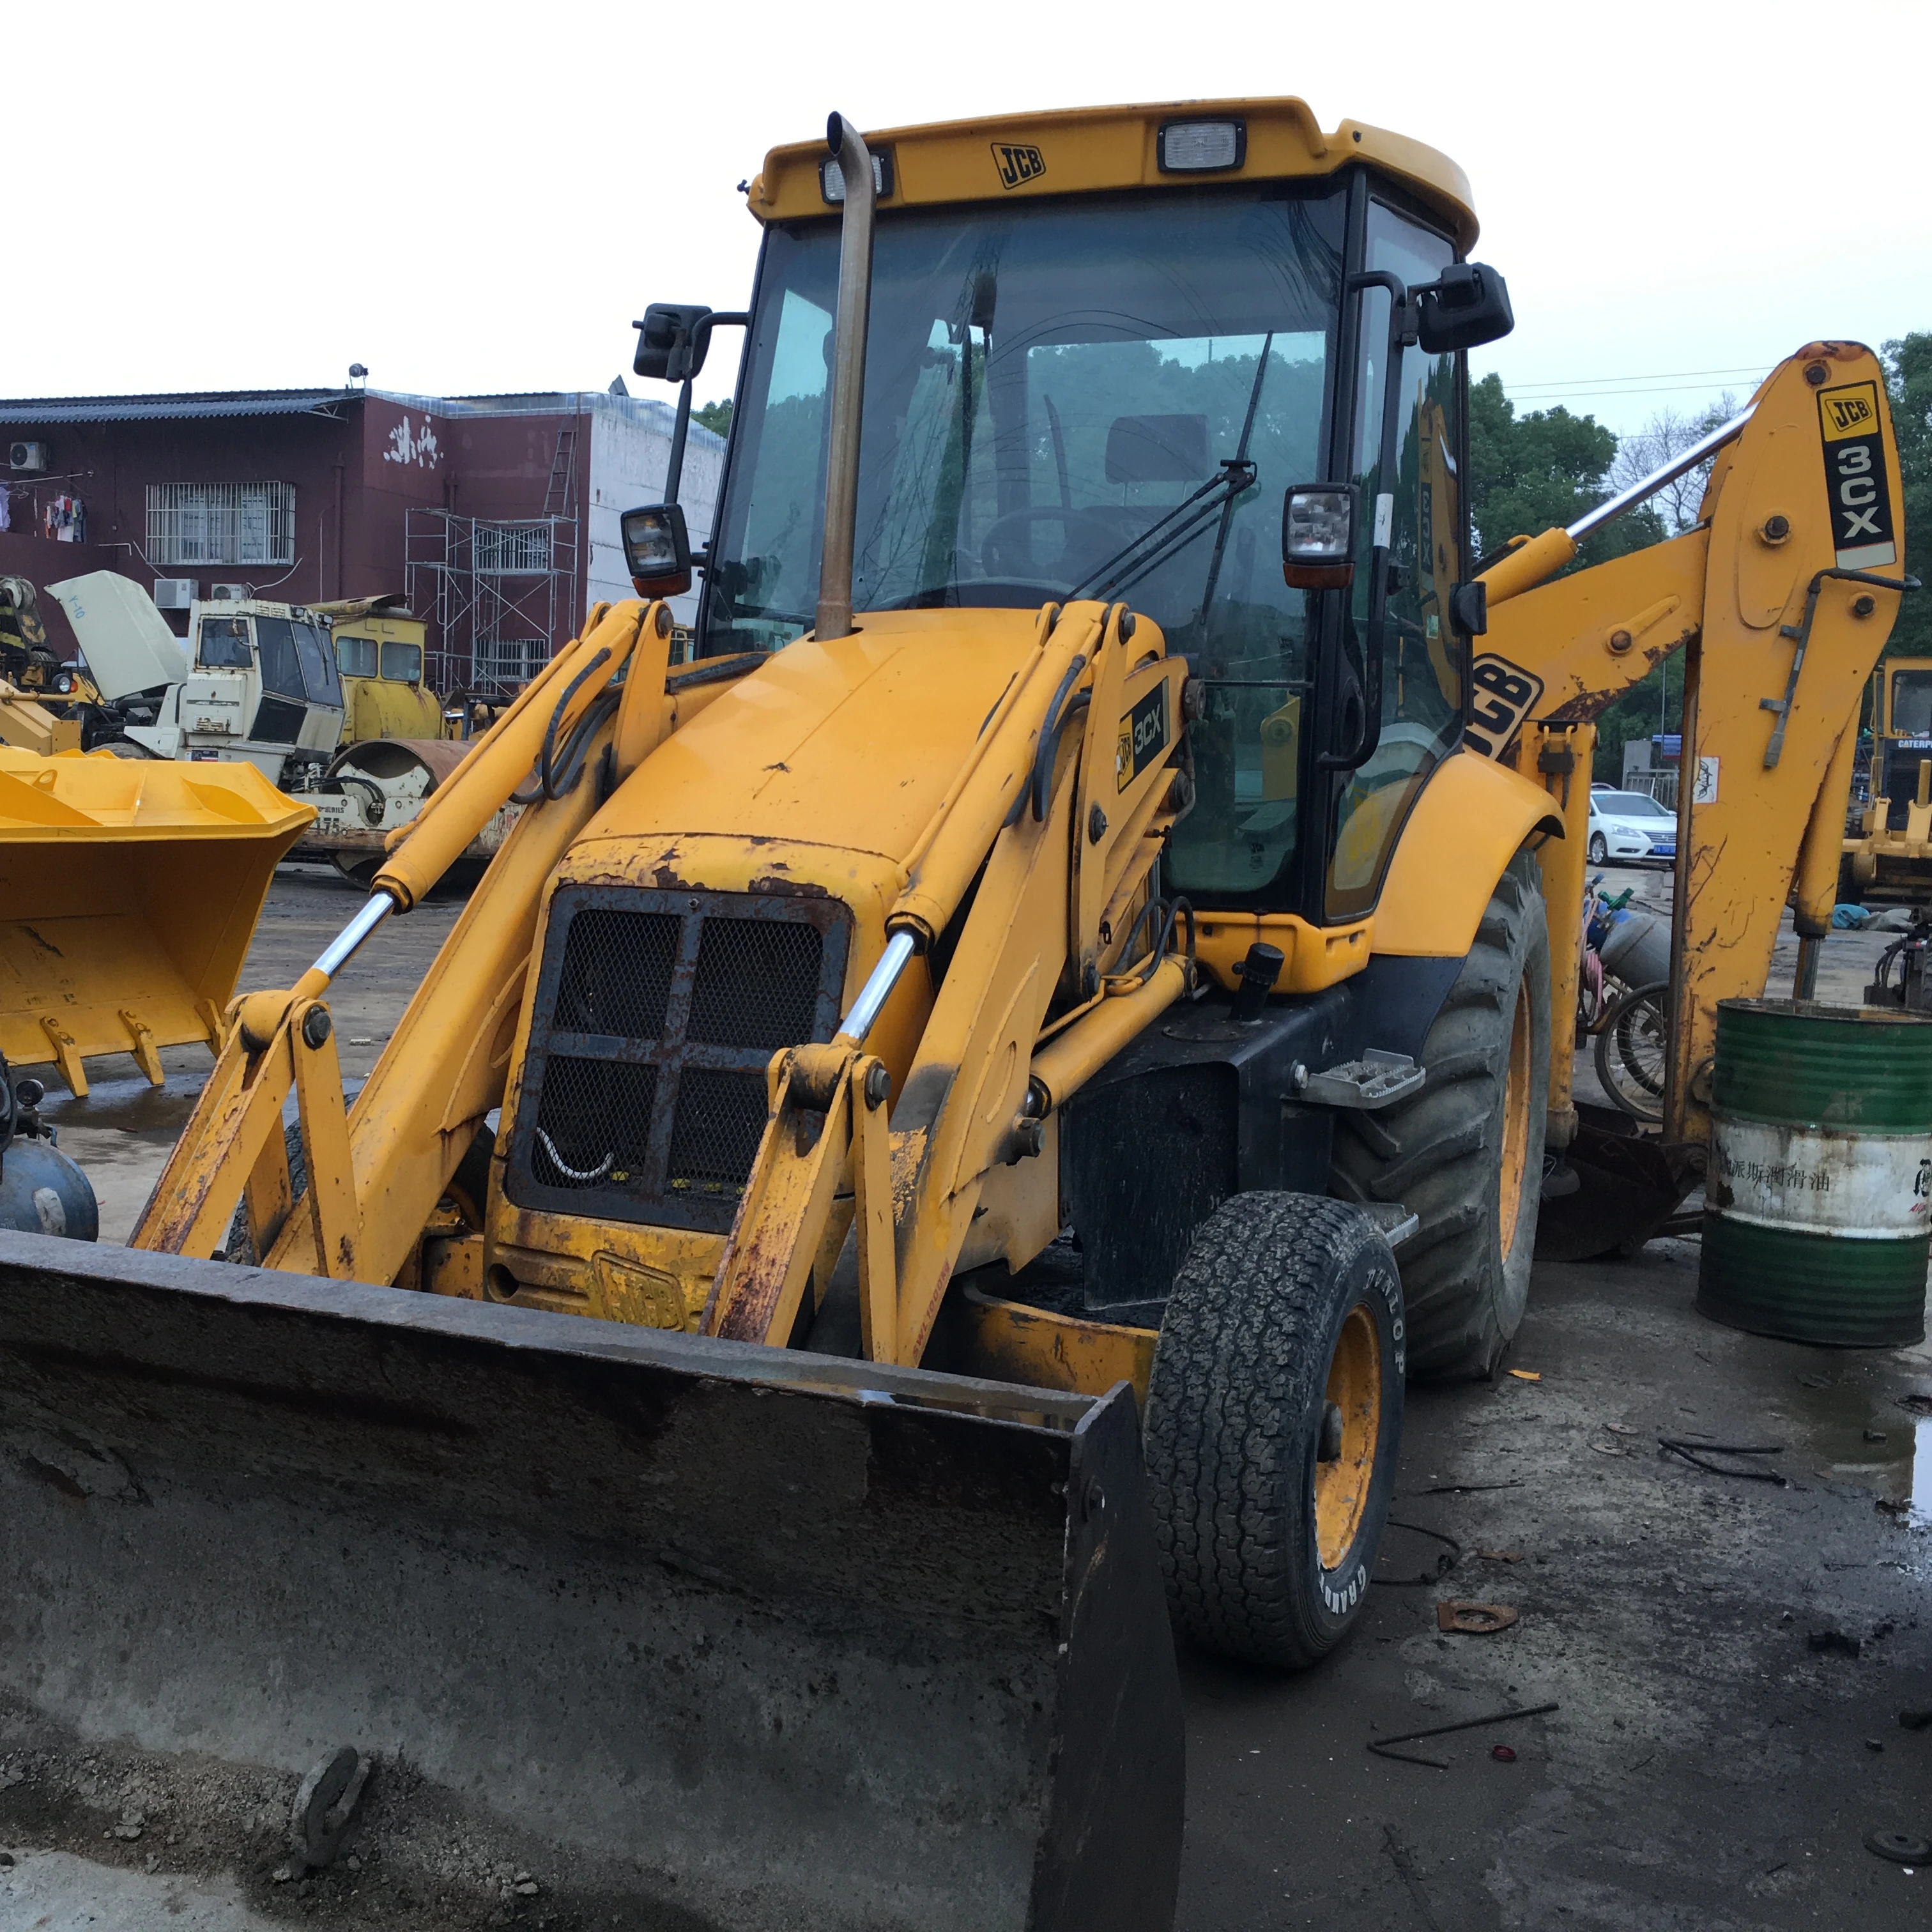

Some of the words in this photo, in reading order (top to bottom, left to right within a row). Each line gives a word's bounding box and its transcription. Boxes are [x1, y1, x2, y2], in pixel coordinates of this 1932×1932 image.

[1000, 148, 1042, 184] JCB
[1833, 401, 1869, 427] JCB
[1837, 445, 1883, 539] 3CX
[1135, 703, 1162, 755] 3CX
[1898, 740, 1932, 748] CATERP
[1362, 1268, 1404, 1374] DUNLOP
